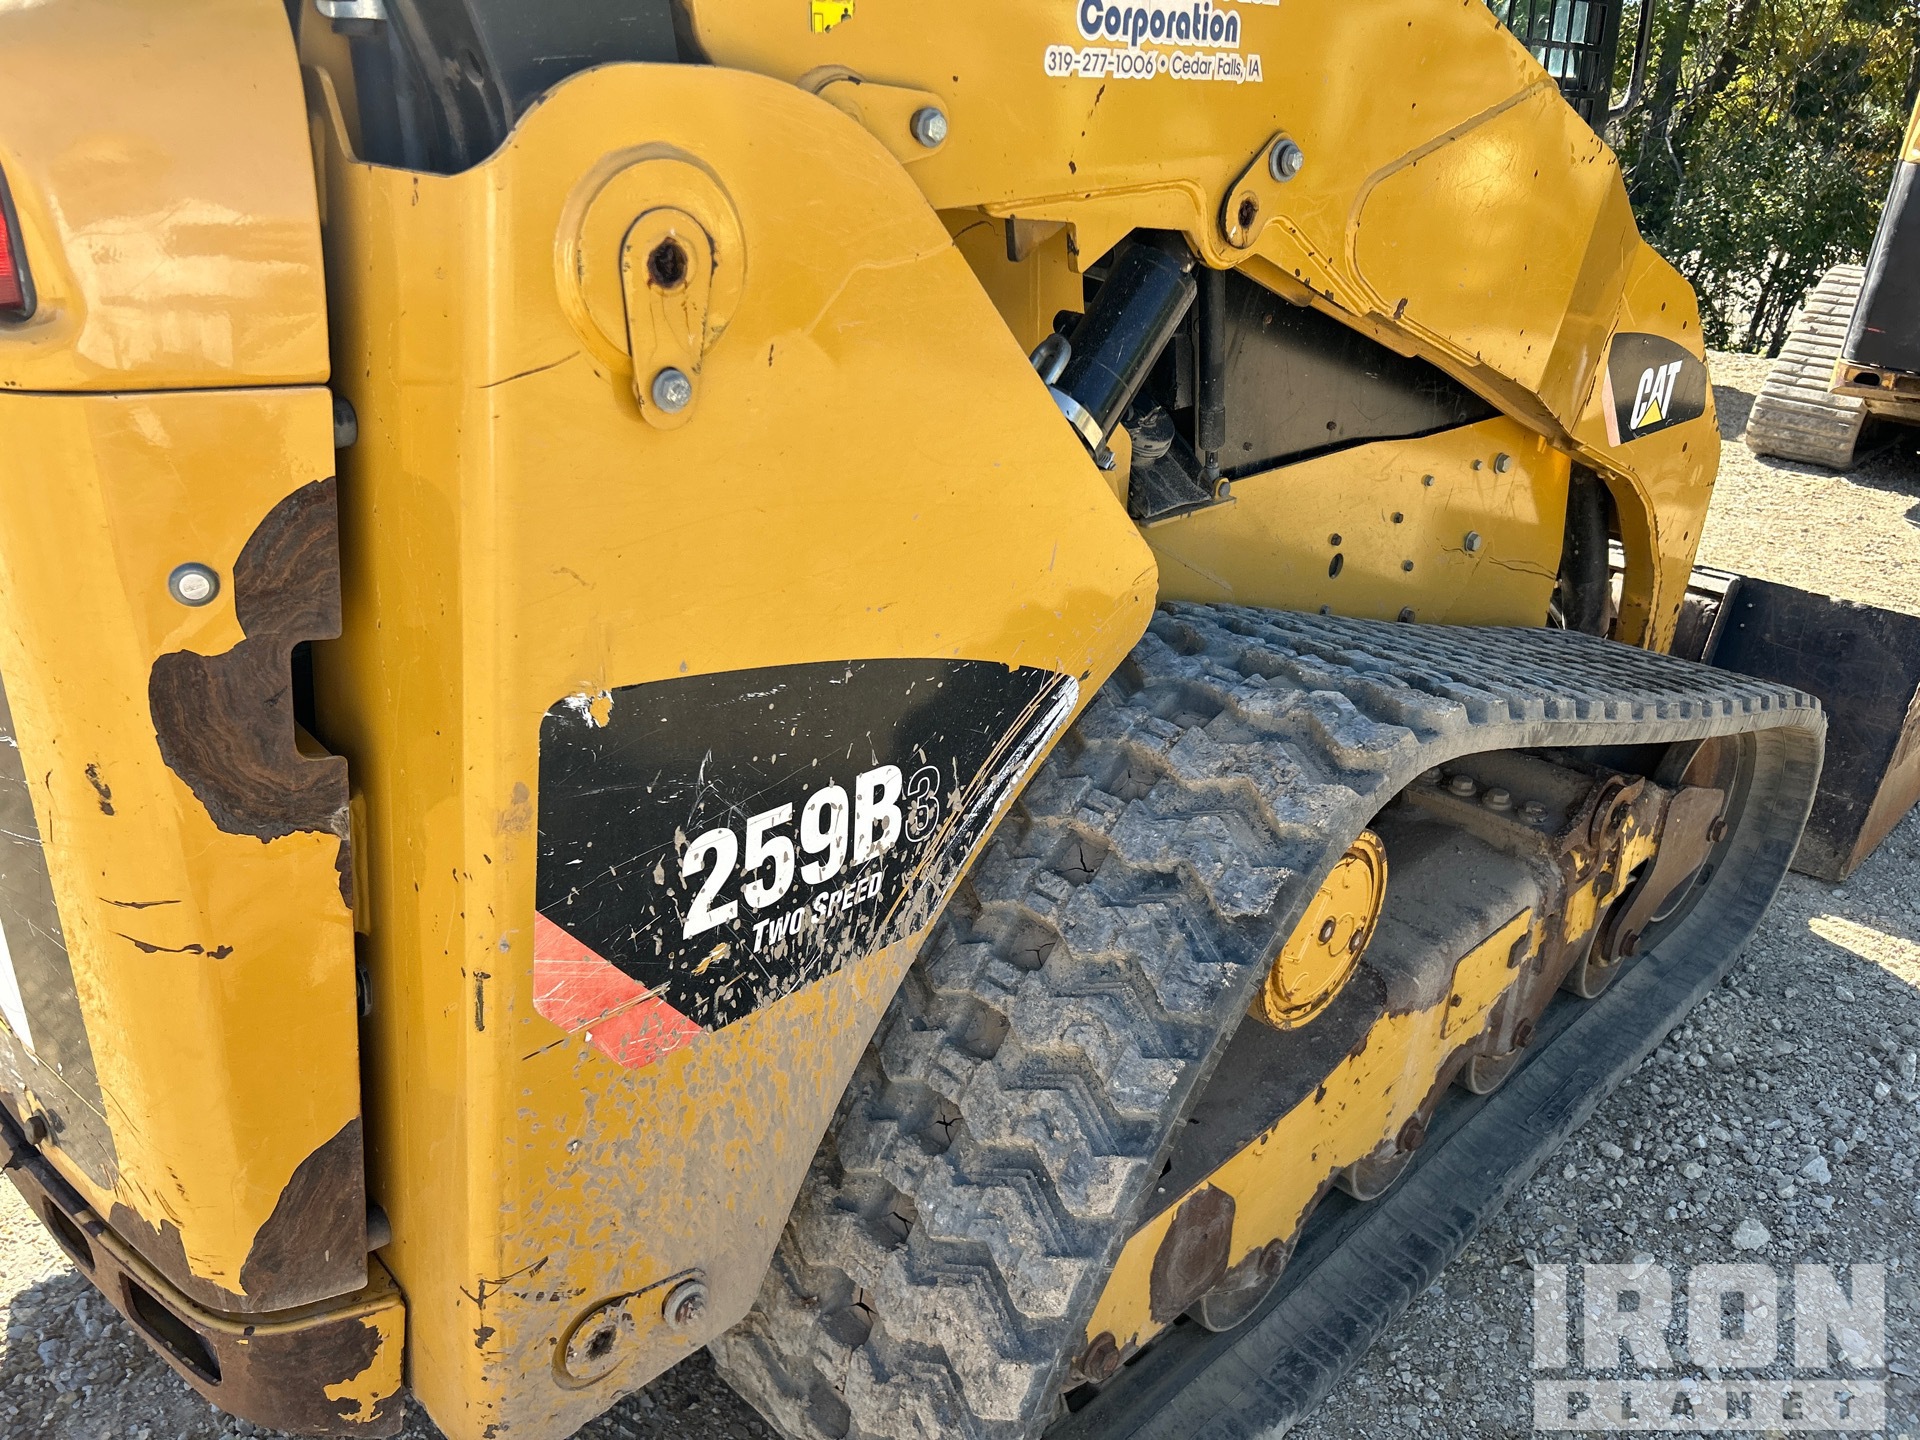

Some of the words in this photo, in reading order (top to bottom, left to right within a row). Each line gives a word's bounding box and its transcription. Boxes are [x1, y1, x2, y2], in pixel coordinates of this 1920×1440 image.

[1080, 0, 1238, 47] Corporation
[1048, 51, 1154, 74] 319-277-1006
[1172, 56, 1212, 75] Cedar
[1217, 57, 1244, 78] Falls,
[1248, 59, 1260, 77] IA
[1630, 360, 1683, 430] CAT
[752, 906, 806, 953] TWO
[811, 872, 883, 924] SPEED
